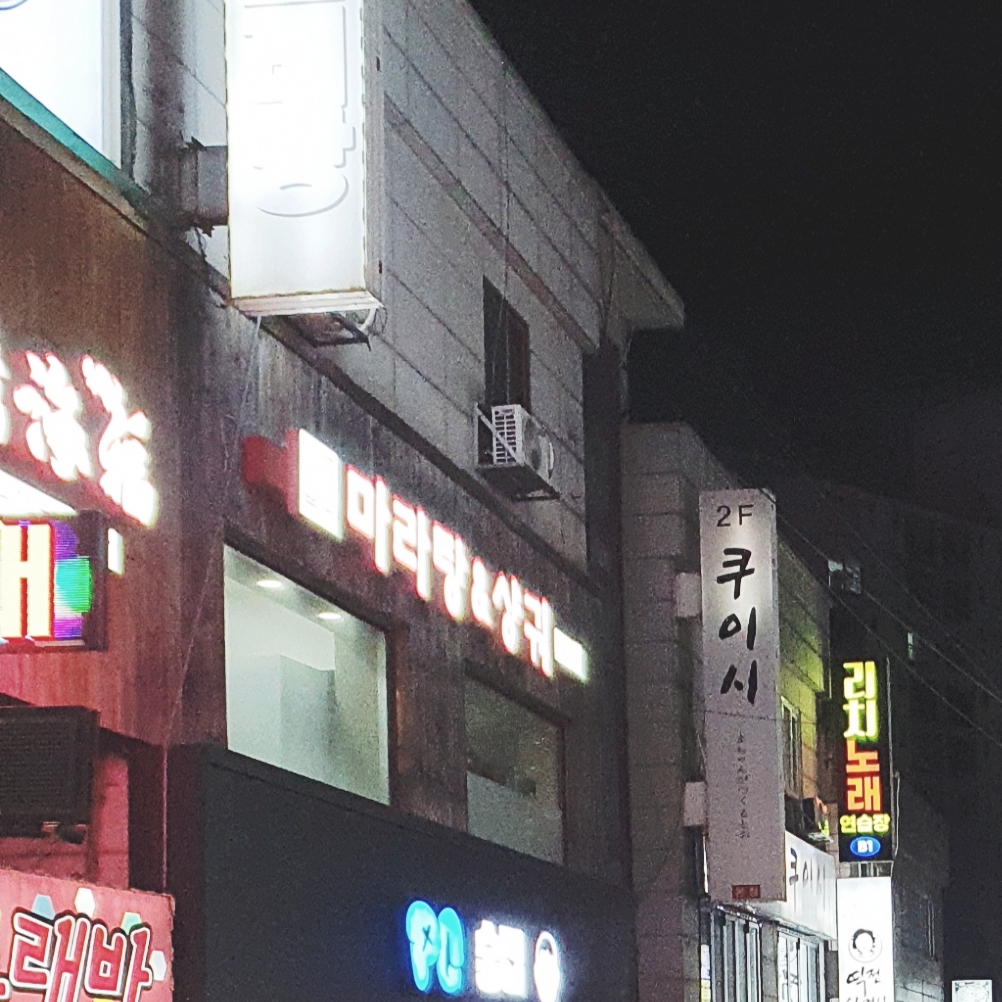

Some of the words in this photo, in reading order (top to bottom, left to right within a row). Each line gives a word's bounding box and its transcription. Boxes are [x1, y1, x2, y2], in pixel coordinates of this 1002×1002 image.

[716, 504, 755, 527] 2F
[839, 814, 891, 834] 연습장
[857, 839, 875, 854] B1
